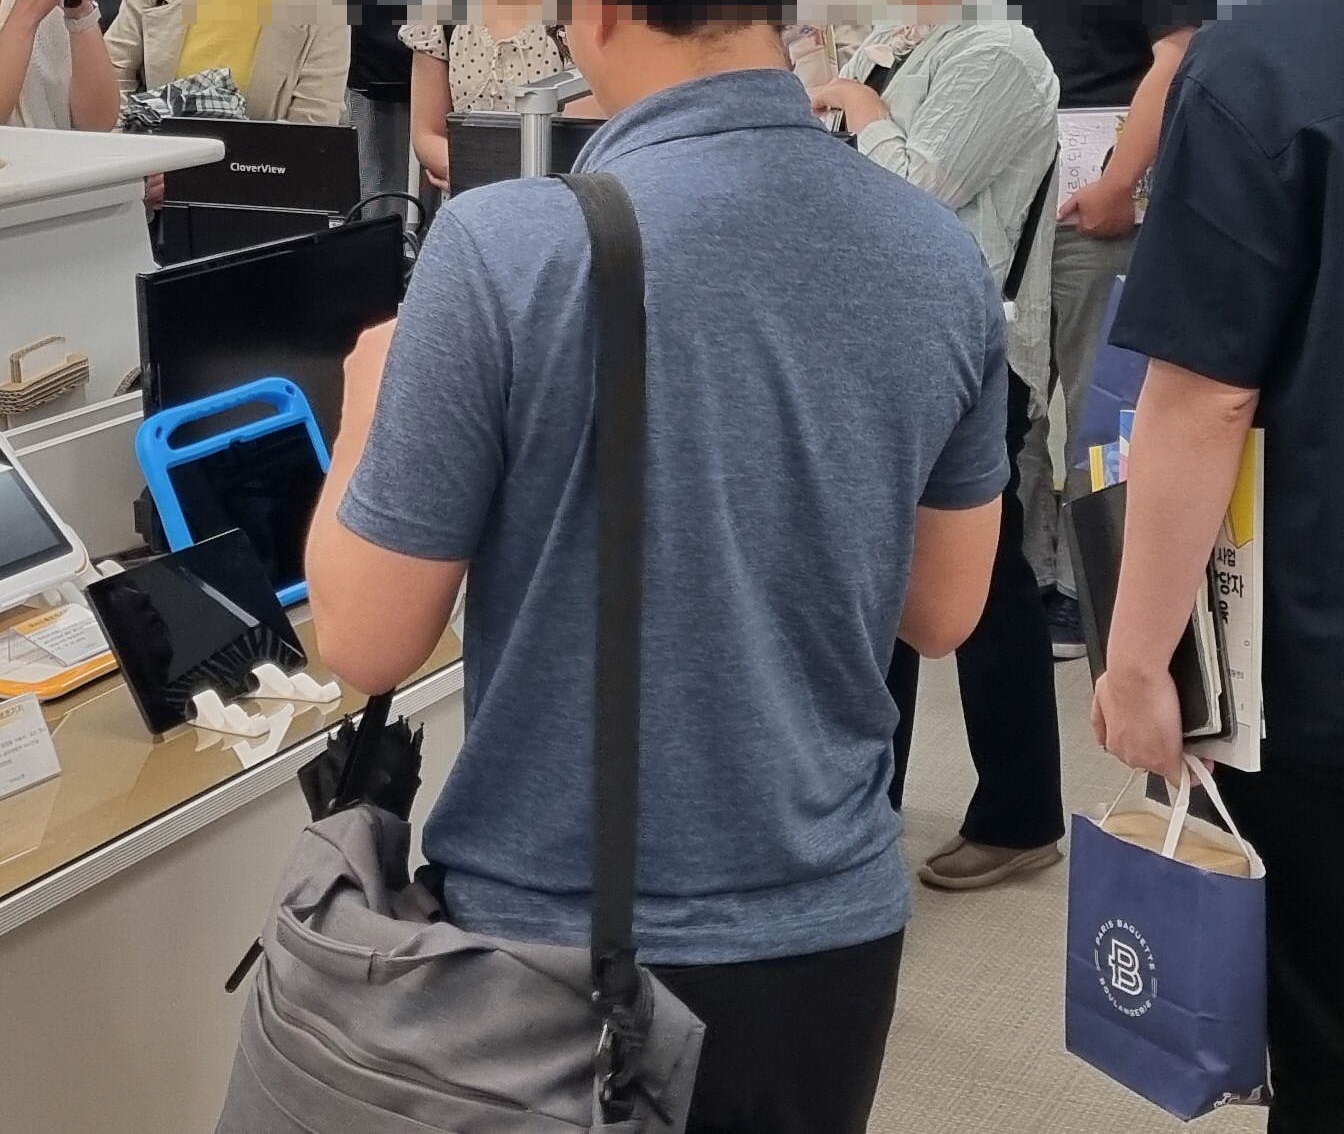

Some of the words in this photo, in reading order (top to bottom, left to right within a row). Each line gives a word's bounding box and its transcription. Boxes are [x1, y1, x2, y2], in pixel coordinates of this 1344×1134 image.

[229, 162, 286, 174] CloverView
[1216, 547, 1236, 568] 사업
[1214, 569, 1244, 599] 당자
[1095, 919, 1114, 947] PARIS
[1116, 919, 1156, 971] BAGUETTE
